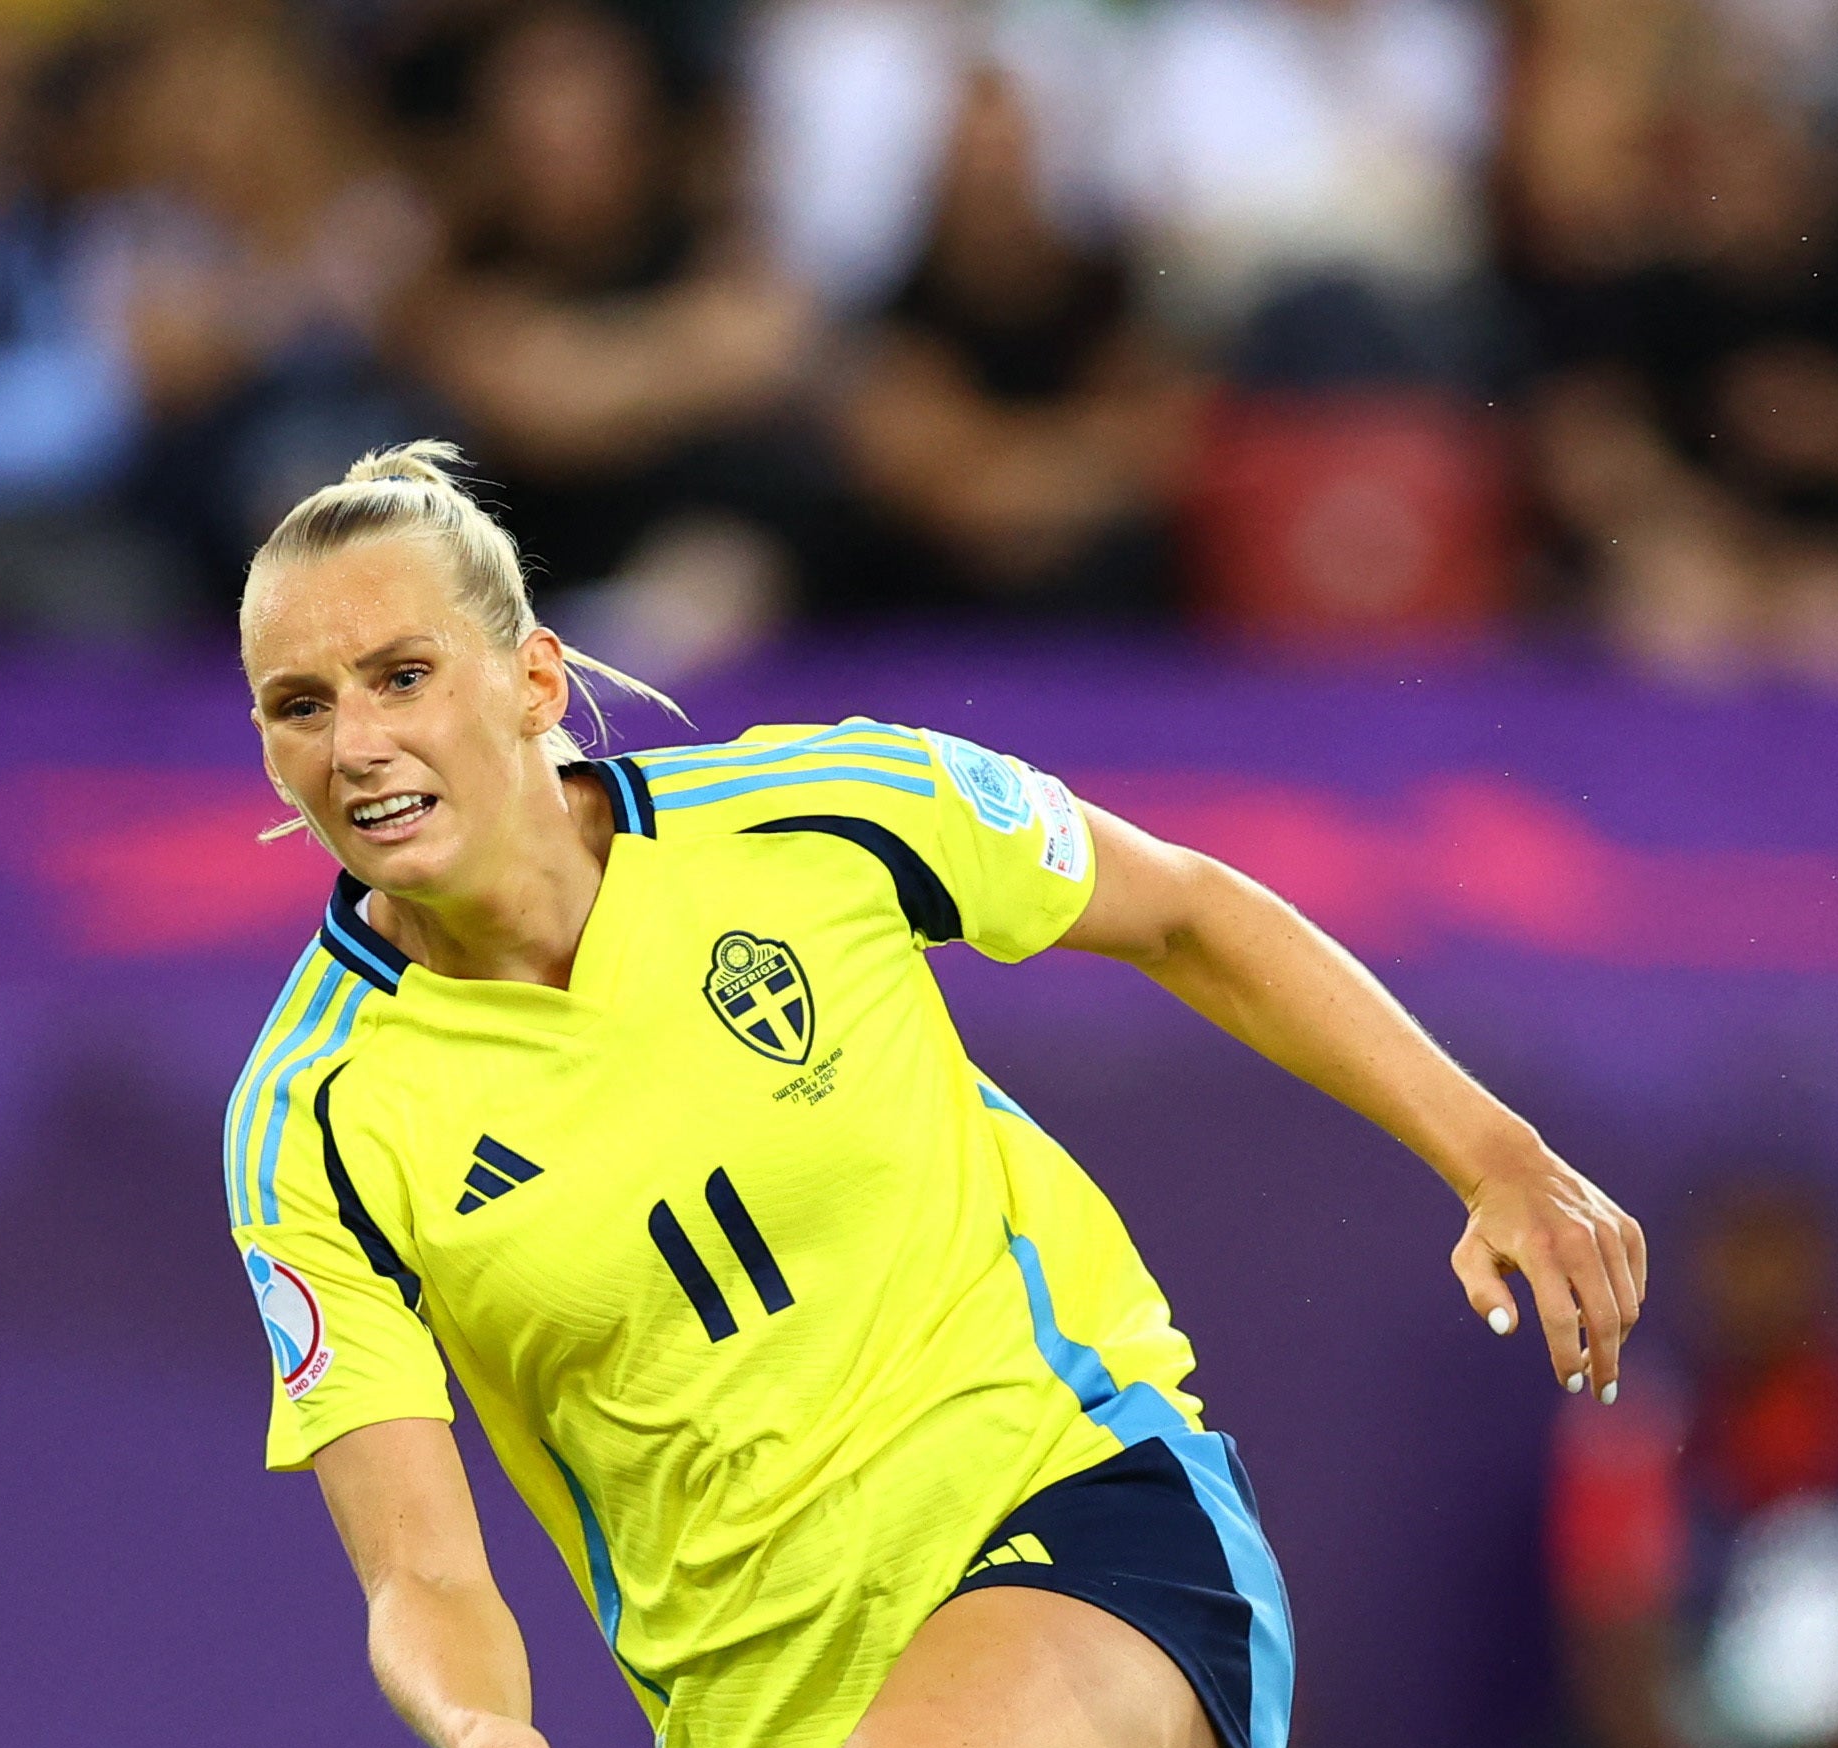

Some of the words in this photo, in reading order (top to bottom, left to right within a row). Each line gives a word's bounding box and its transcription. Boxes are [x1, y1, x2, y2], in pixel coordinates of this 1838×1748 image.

[723, 959, 780, 998] SVERIGE
[772, 1076, 807, 1103] SWEDEN
[812, 1047, 844, 1077] ENGLAND
[790, 1093, 800, 1105] 17
[800, 1080, 819, 1097] JULY
[818, 1066, 839, 1085] 2025
[648, 1165, 796, 1344] 11
[307, 1350, 330, 1380] 2025
